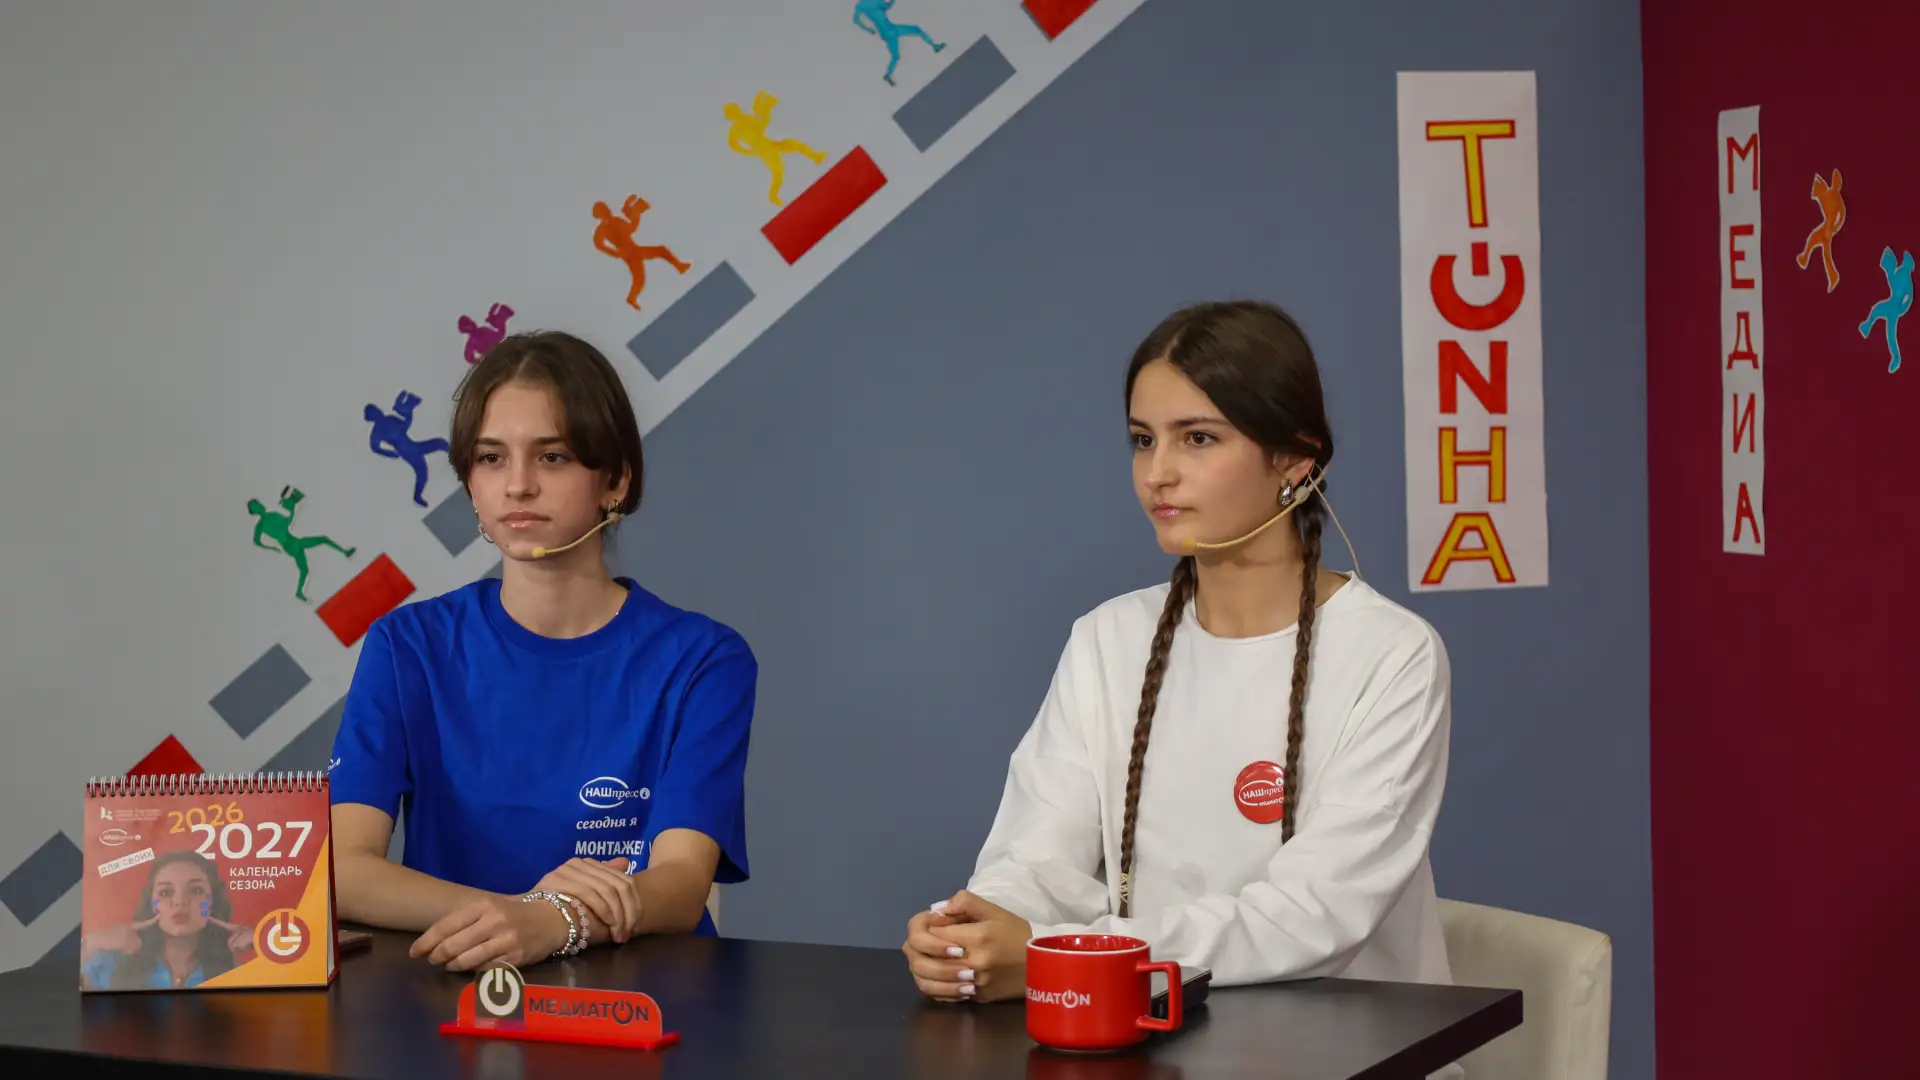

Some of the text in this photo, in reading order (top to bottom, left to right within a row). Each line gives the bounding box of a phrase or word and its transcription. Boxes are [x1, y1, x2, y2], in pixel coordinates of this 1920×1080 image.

[1726, 133, 1760, 543] МЕДИА
[167, 801, 244, 834] 2026
[576, 815, 638, 830] сегодня я
[191, 821, 312, 859] 2027
[575, 840, 645, 855] МОНТАЖЕ
[123, 851, 153, 866] СВОИХ
[229, 866, 302, 878] КАЛЕНДАРЬ
[229, 880, 275, 890] СЕЗОНА
